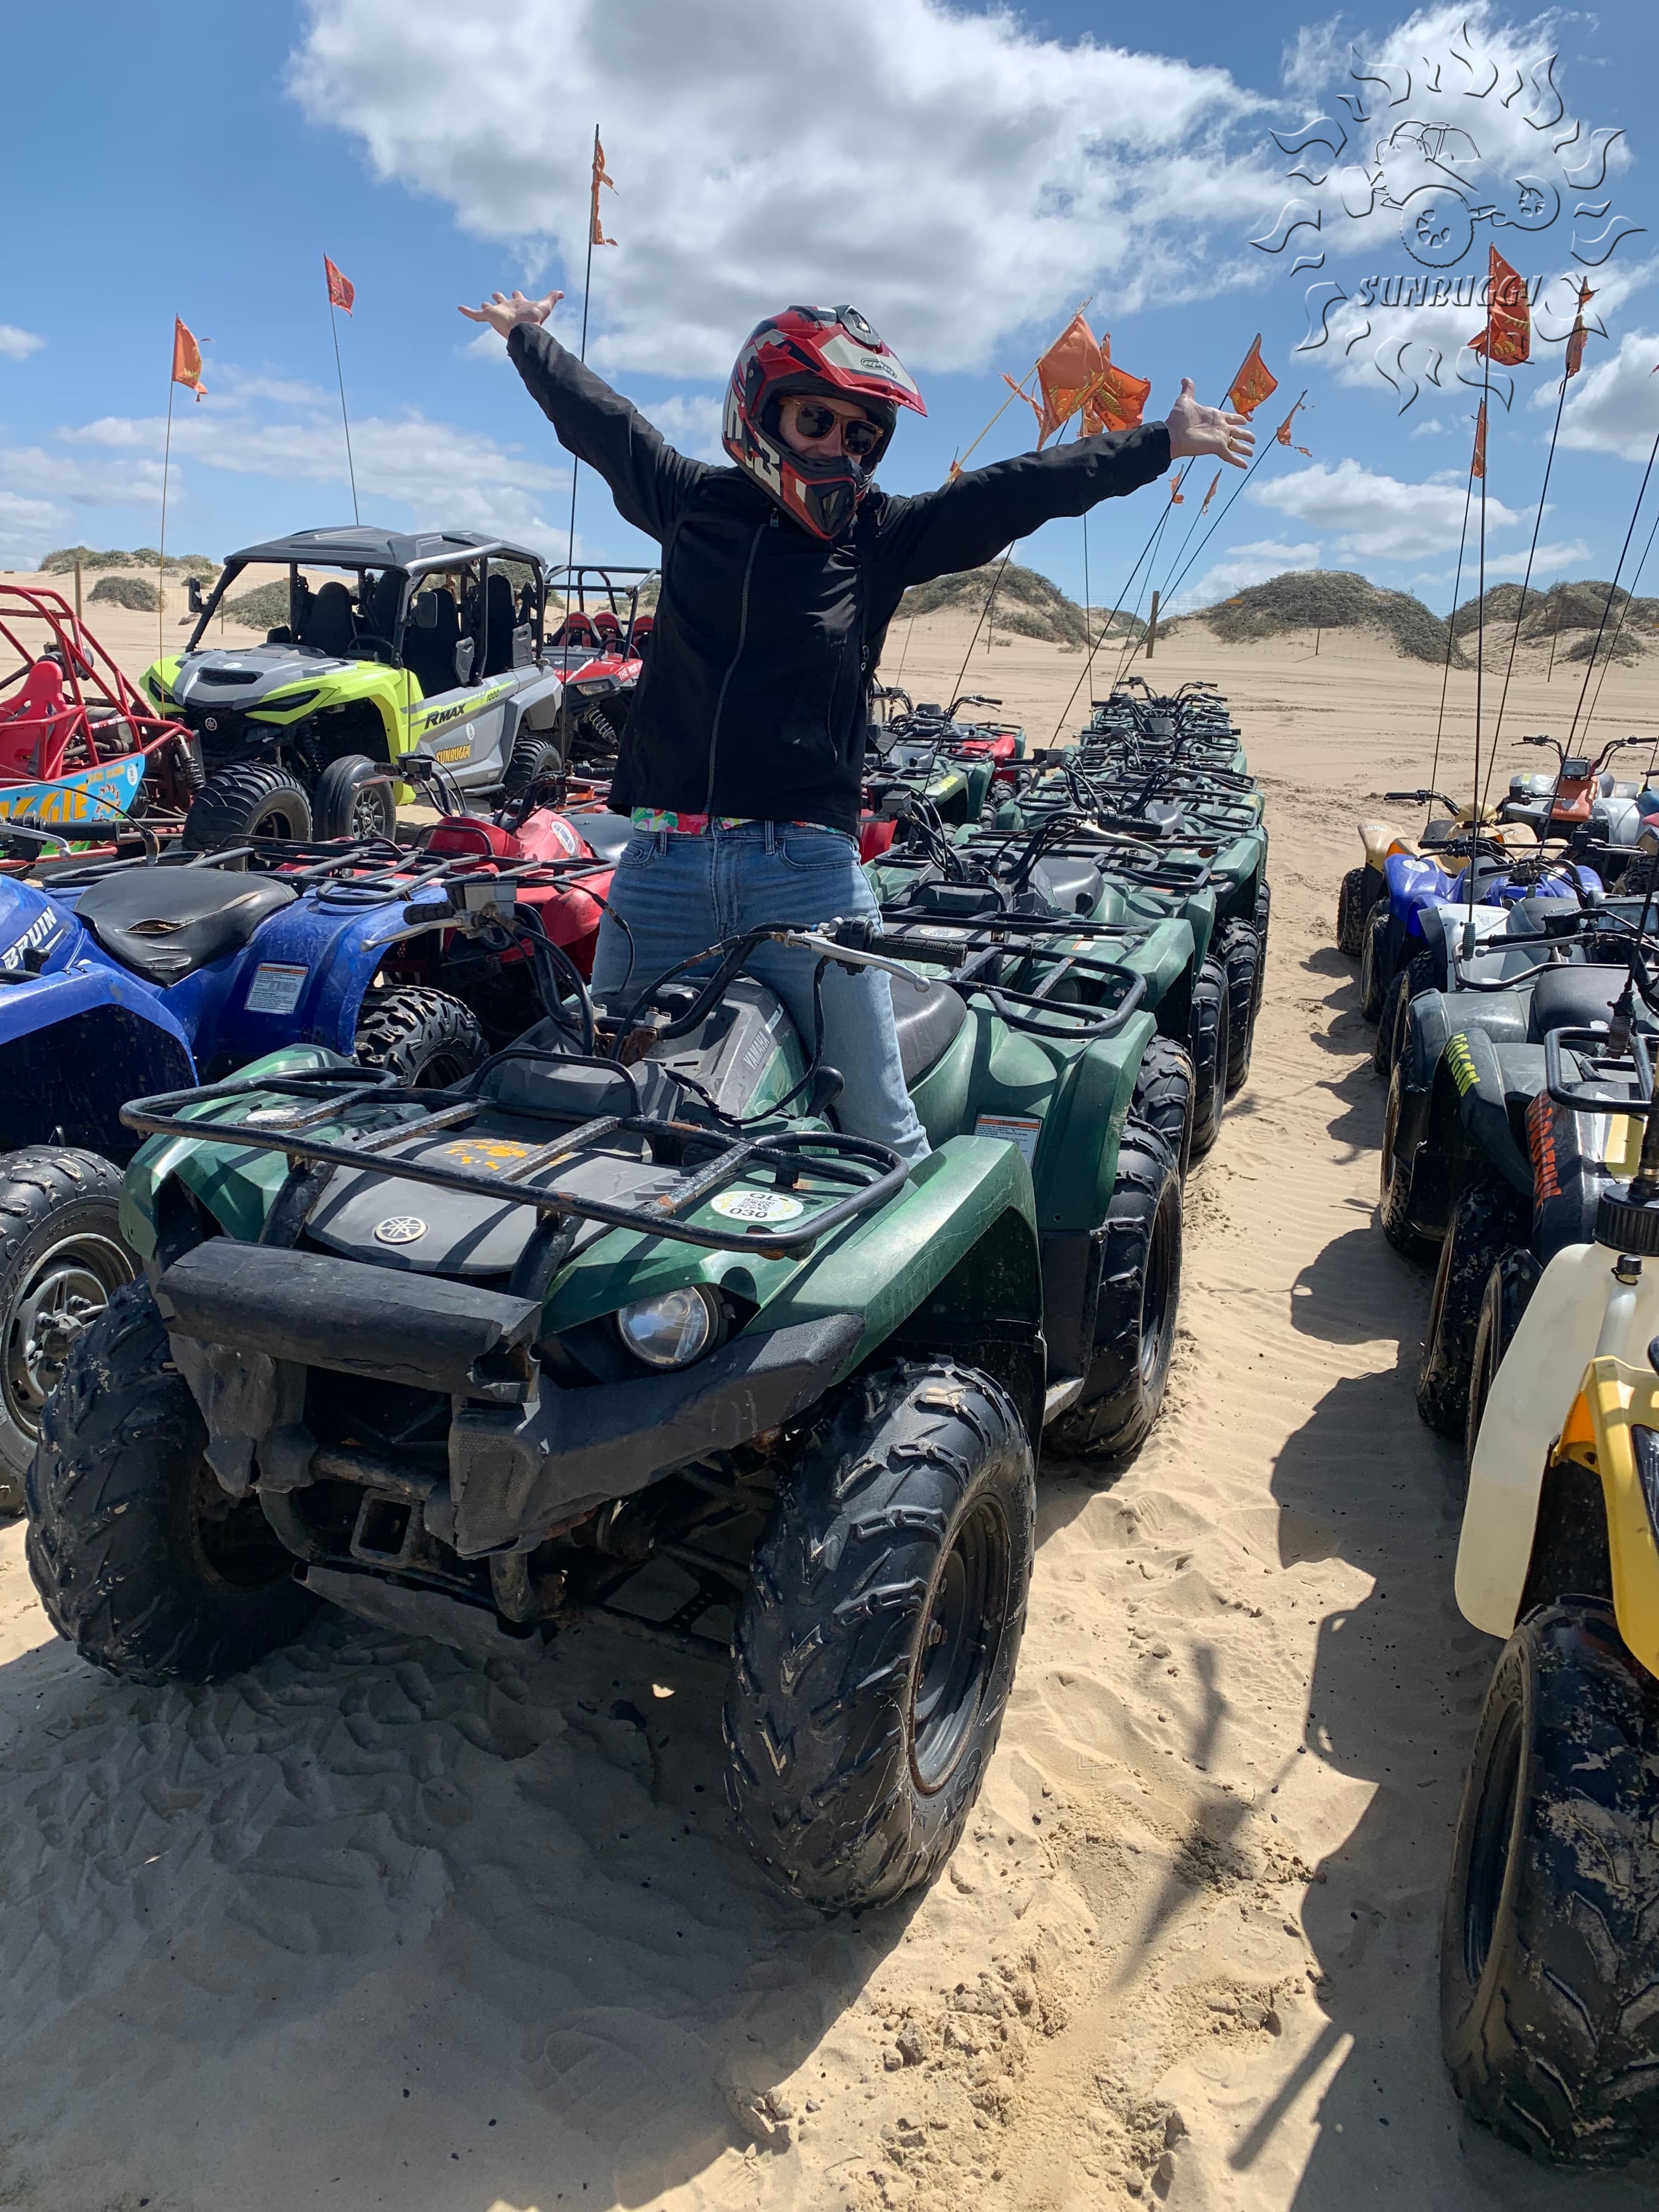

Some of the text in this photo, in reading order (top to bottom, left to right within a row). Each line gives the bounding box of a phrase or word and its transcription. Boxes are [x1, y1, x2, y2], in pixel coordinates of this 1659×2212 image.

[424, 703, 466, 730] RMAX
[436, 743, 471, 764] SUNBUGGY
[0, 906, 58, 970] BRUIN
[743, 1030, 771, 1071] YAMAHA
[729, 1207, 768, 1218] 030
